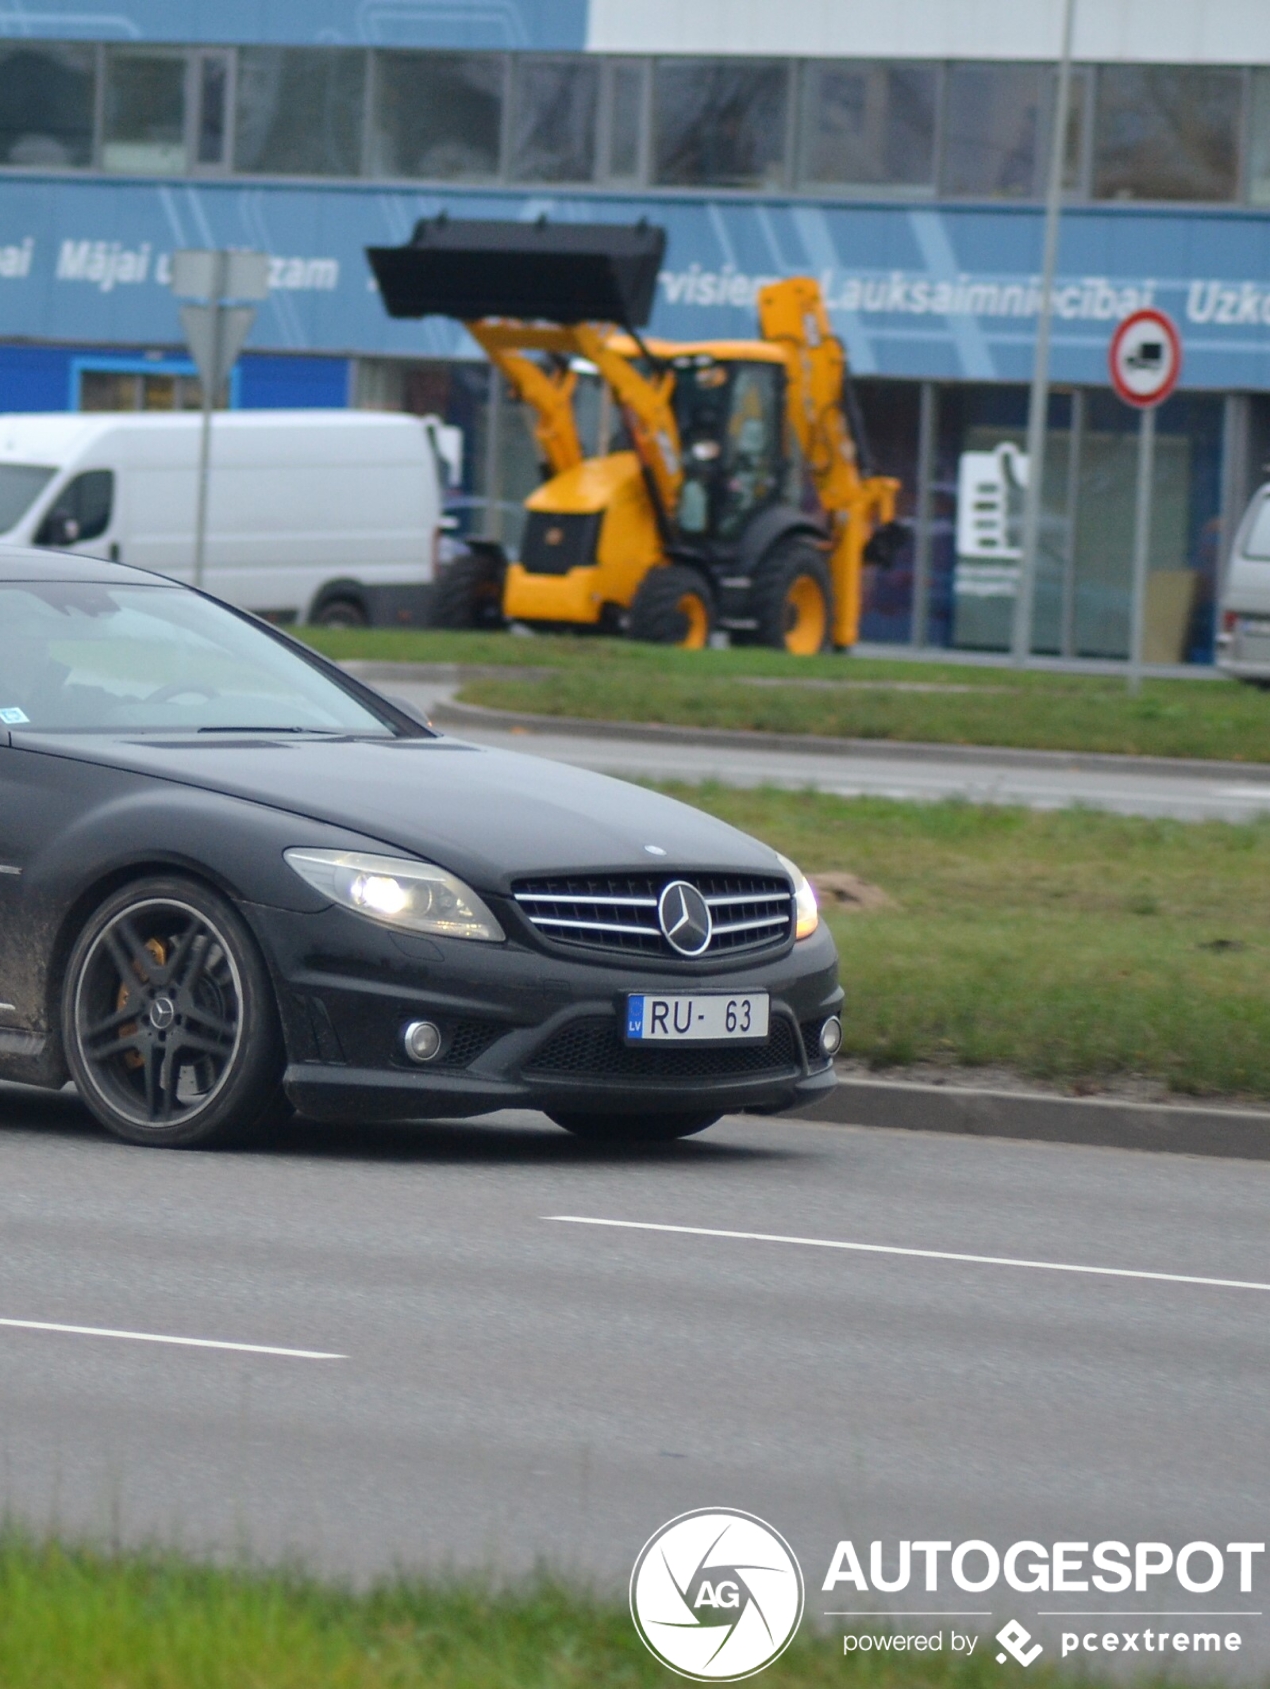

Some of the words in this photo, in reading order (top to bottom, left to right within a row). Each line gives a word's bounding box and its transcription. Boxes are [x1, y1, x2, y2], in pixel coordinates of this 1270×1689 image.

[55, 239, 152, 292] Mājai
[629, 1021, 642, 1032] LV
[725, 1000, 751, 1032] 63
